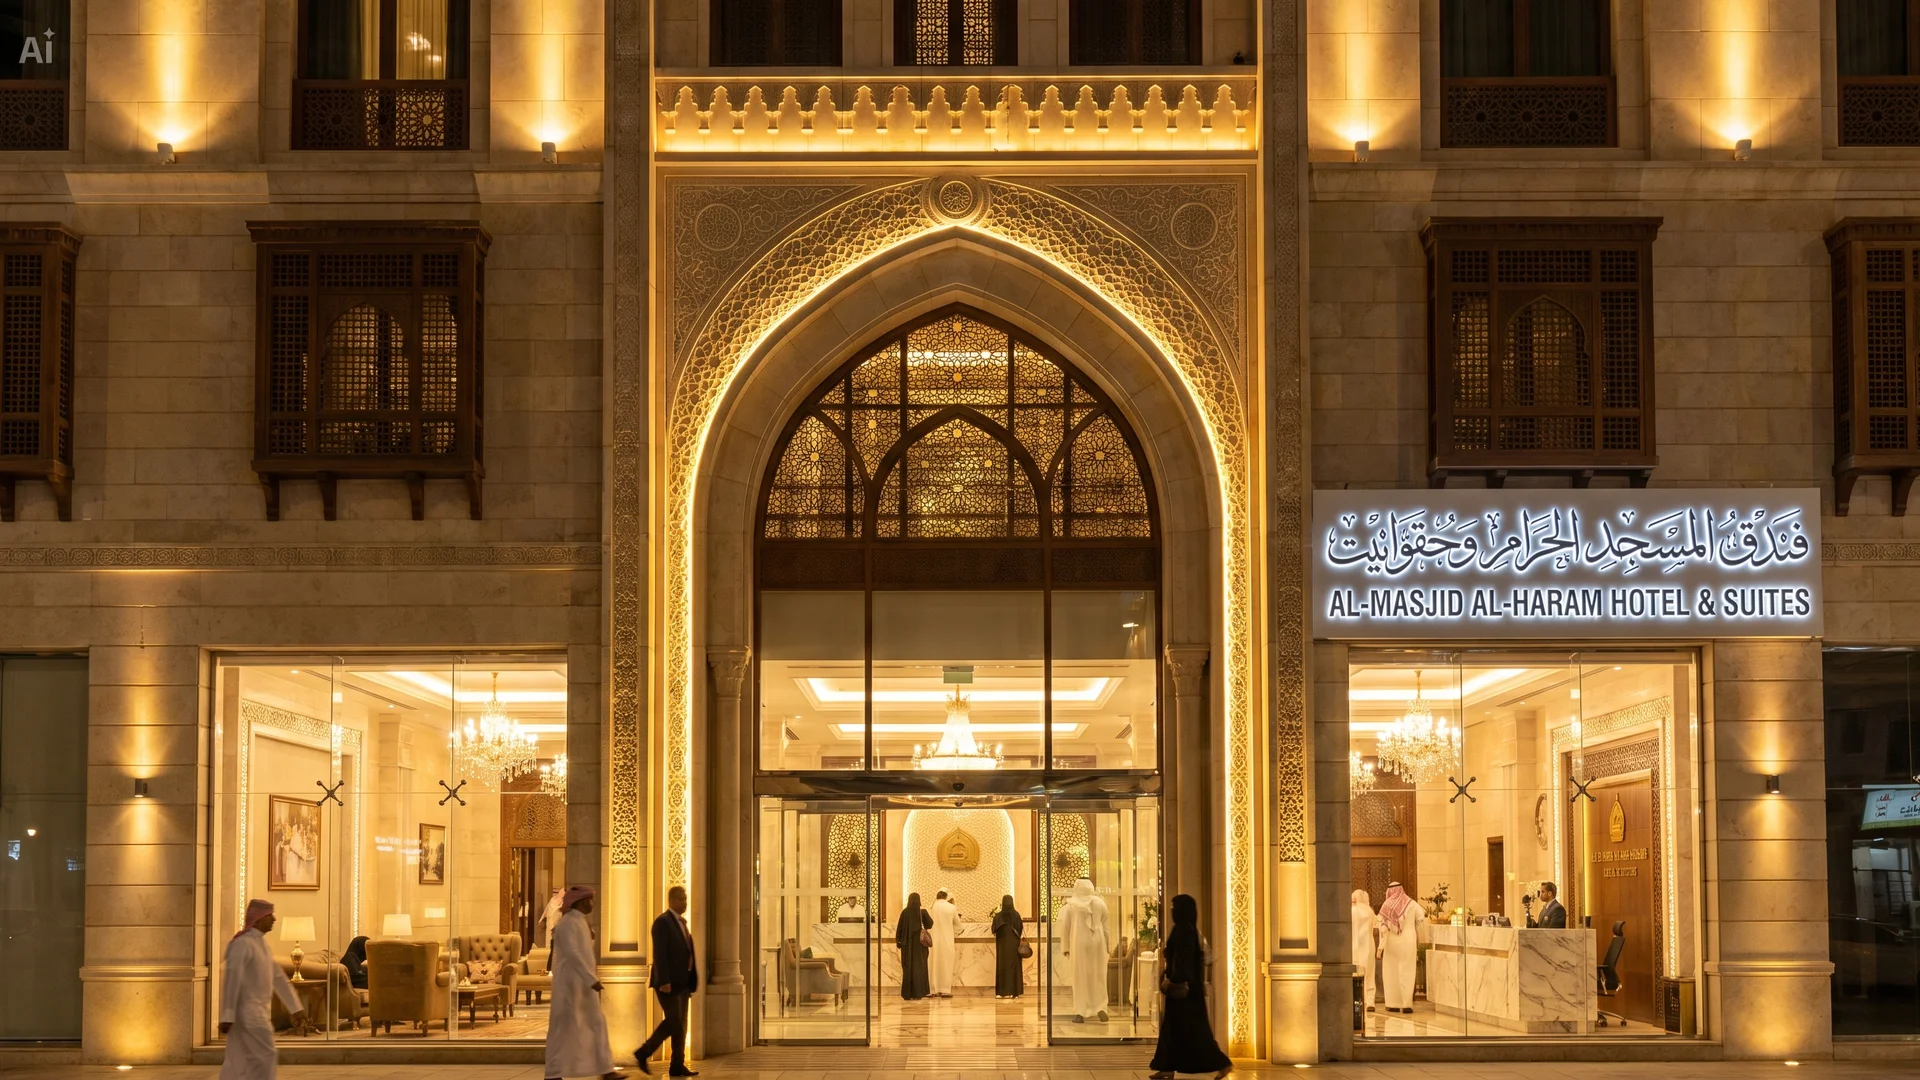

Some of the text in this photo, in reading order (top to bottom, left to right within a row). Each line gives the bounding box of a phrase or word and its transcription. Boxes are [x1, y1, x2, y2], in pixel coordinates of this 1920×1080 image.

[1328, 588, 1810, 617] AL-MASJID AL-HARAM HOTEL & SUITES
